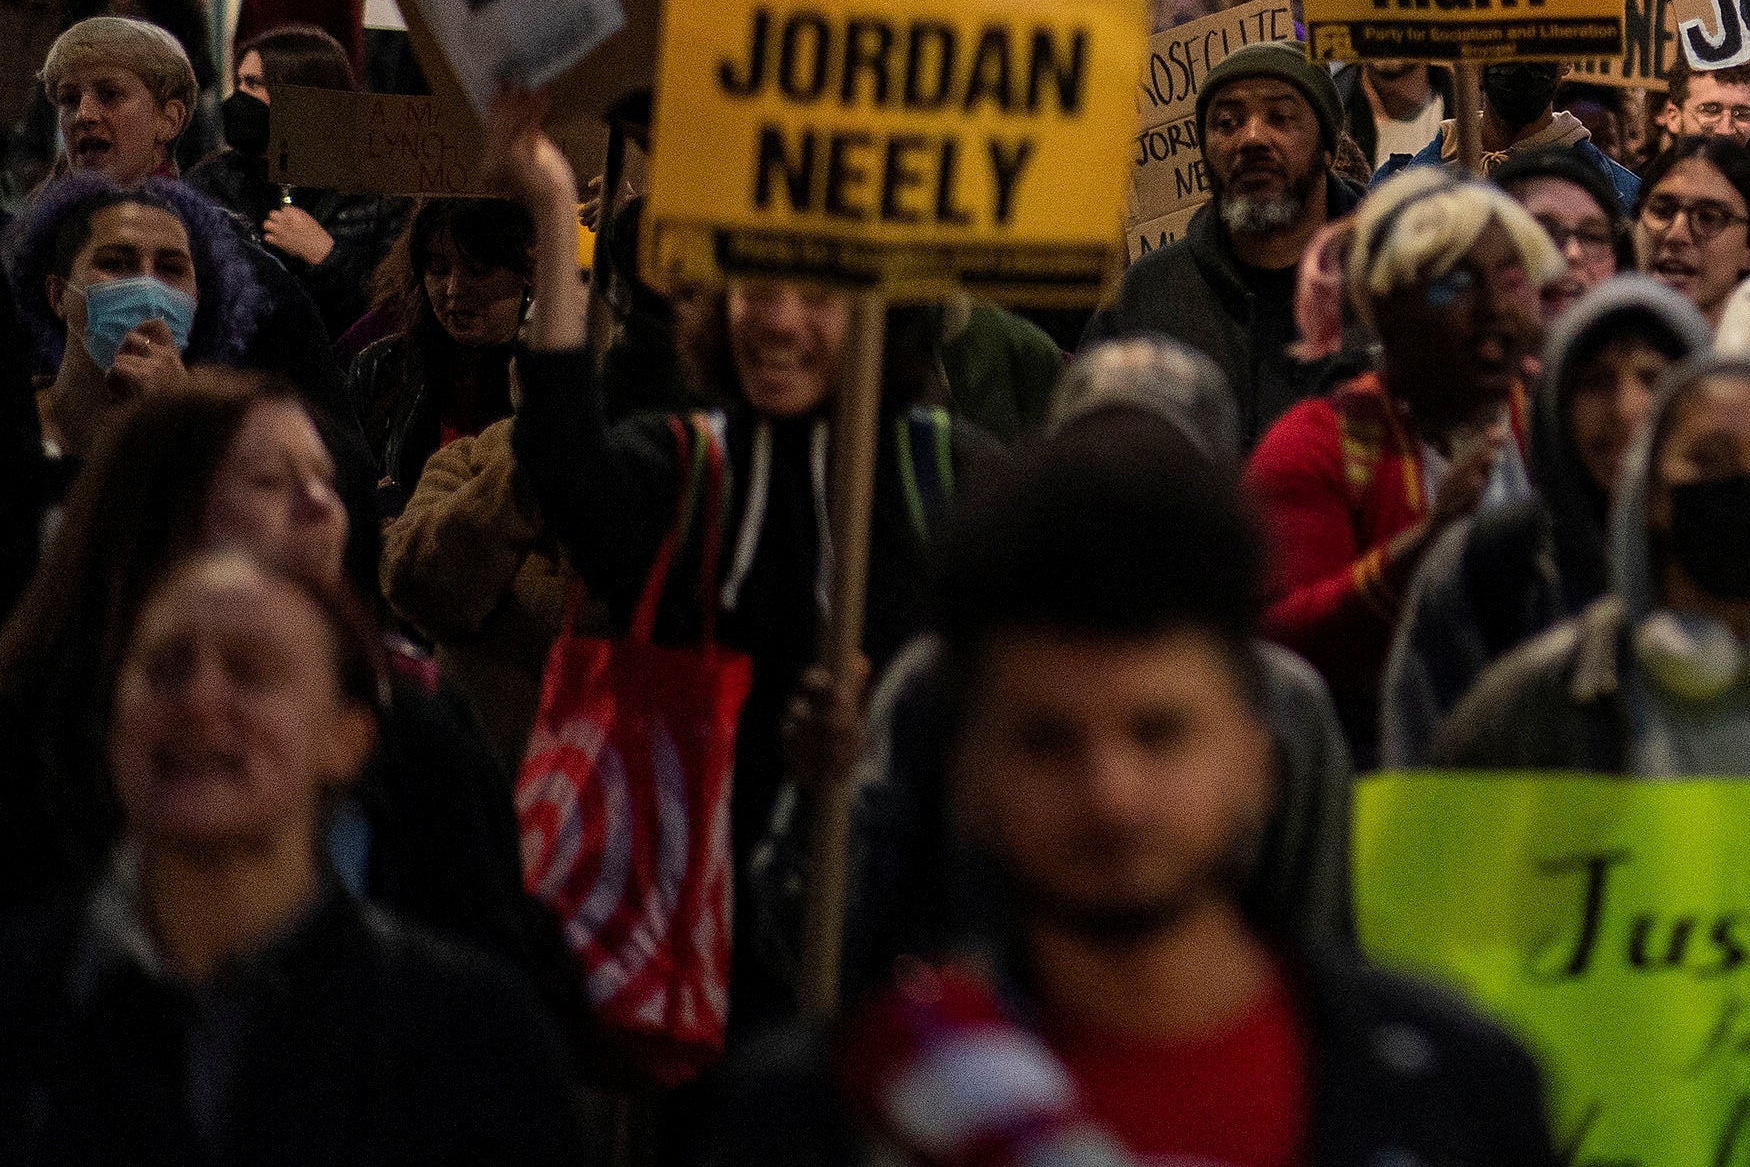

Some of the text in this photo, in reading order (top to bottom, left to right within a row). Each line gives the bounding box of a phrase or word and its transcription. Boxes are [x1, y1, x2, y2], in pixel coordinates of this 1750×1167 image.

[714, 6, 1090, 117] JORDAN
[367, 130, 458, 160] LYNCH
[754, 125, 1038, 228] NEELY
